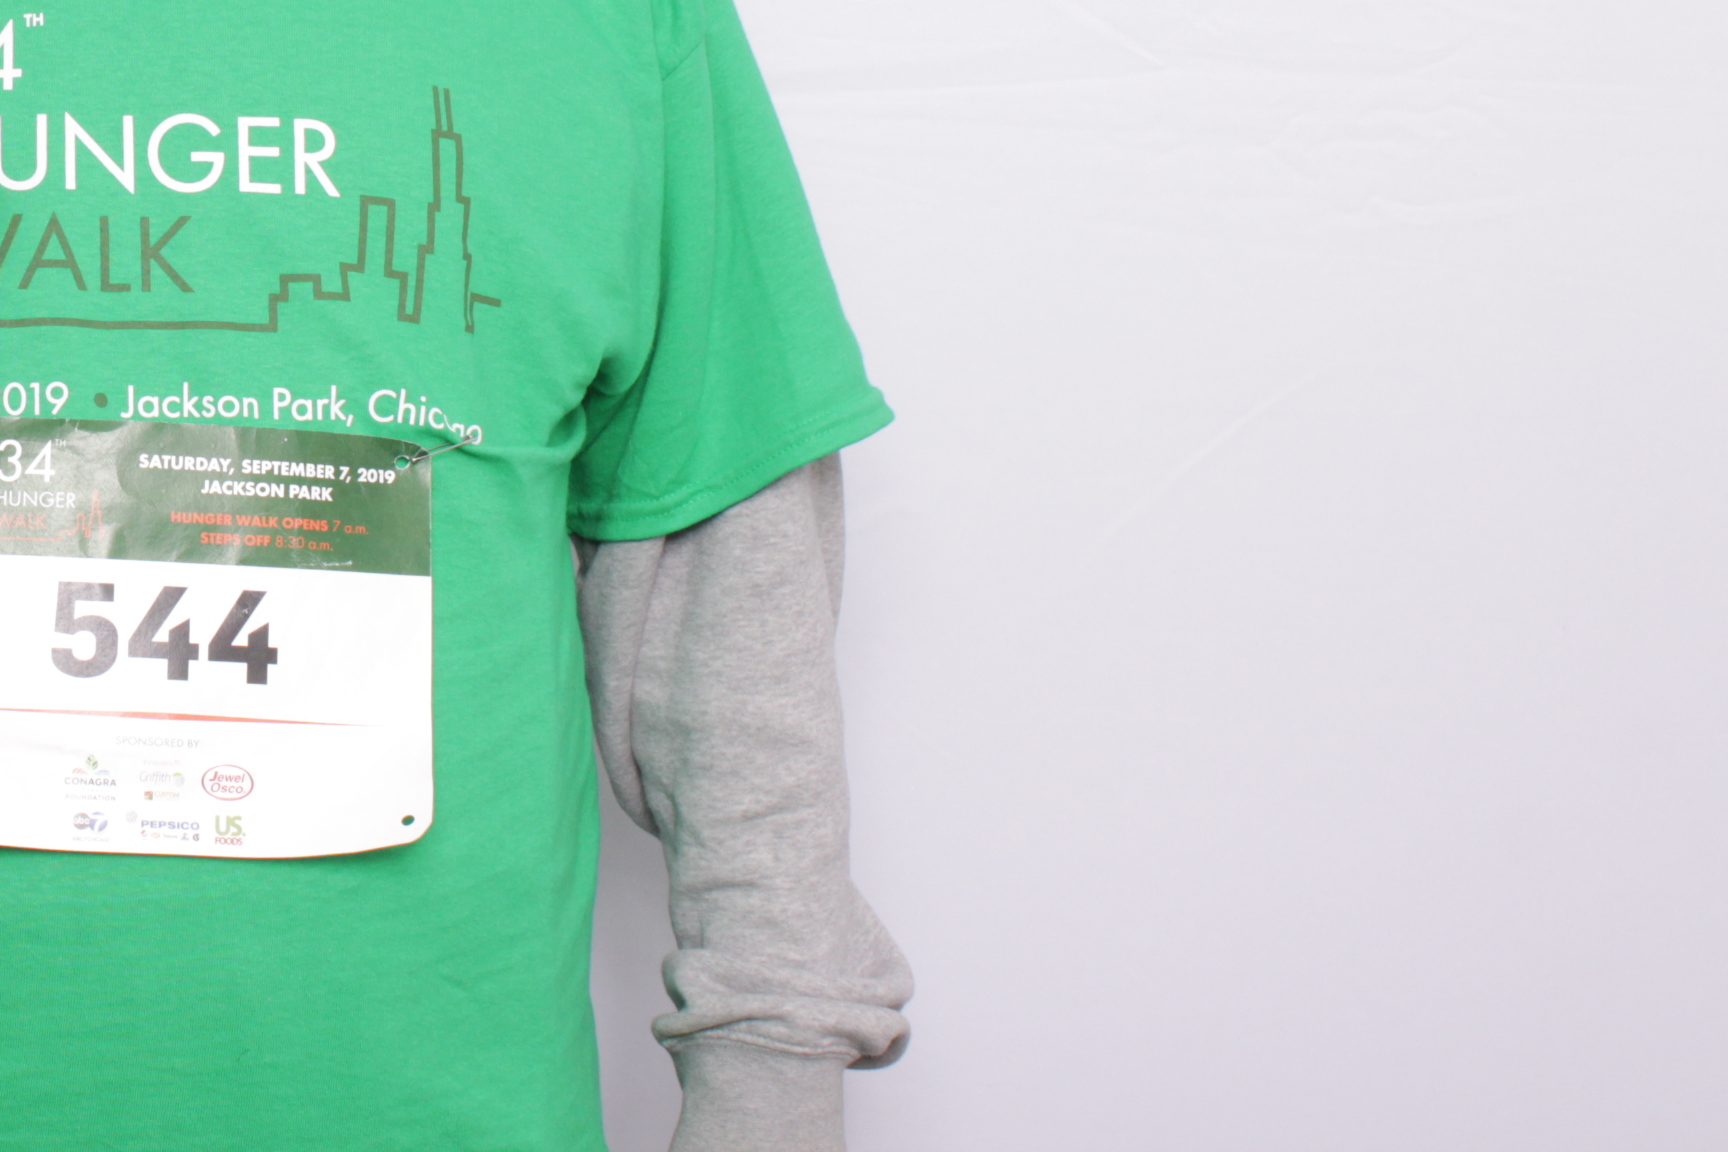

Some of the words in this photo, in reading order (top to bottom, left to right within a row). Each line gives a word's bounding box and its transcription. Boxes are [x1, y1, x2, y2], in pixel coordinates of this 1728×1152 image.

[119, 381, 261, 420] Jackson
[272, 384, 355, 428] Park,
[368, 388, 483, 446] Chico
[139, 453, 235, 476] SATURDAY,
[241, 459, 335, 480] SEPTEMBER
[338, 466, 352, 484] 7,
[357, 468, 396, 484] 2019
[200, 480, 285, 498] JACKSON
[288, 484, 334, 502] PARK
[170, 511, 233, 526] HUNGER
[234, 514, 279, 528] WALK
[281, 517, 329, 532] OPENS
[332, 520, 341, 533] 7
[344, 523, 370, 535] a.m.
[200, 531, 240, 546] STEPS
[244, 534, 271, 547] OFF
[274, 535, 305, 550] 8:30
[308, 538, 334, 551] a.m.
[50, 580, 278, 685] 544
[115, 735, 184, 748] SPONSORED
[64, 777, 117, 787] CONAGRA
[209, 770, 245, 783] Jewel
[65, 793, 116, 802] FOUNDATION
[140, 819, 201, 831] PEPSICO
[215, 837, 243, 846] FOODS
